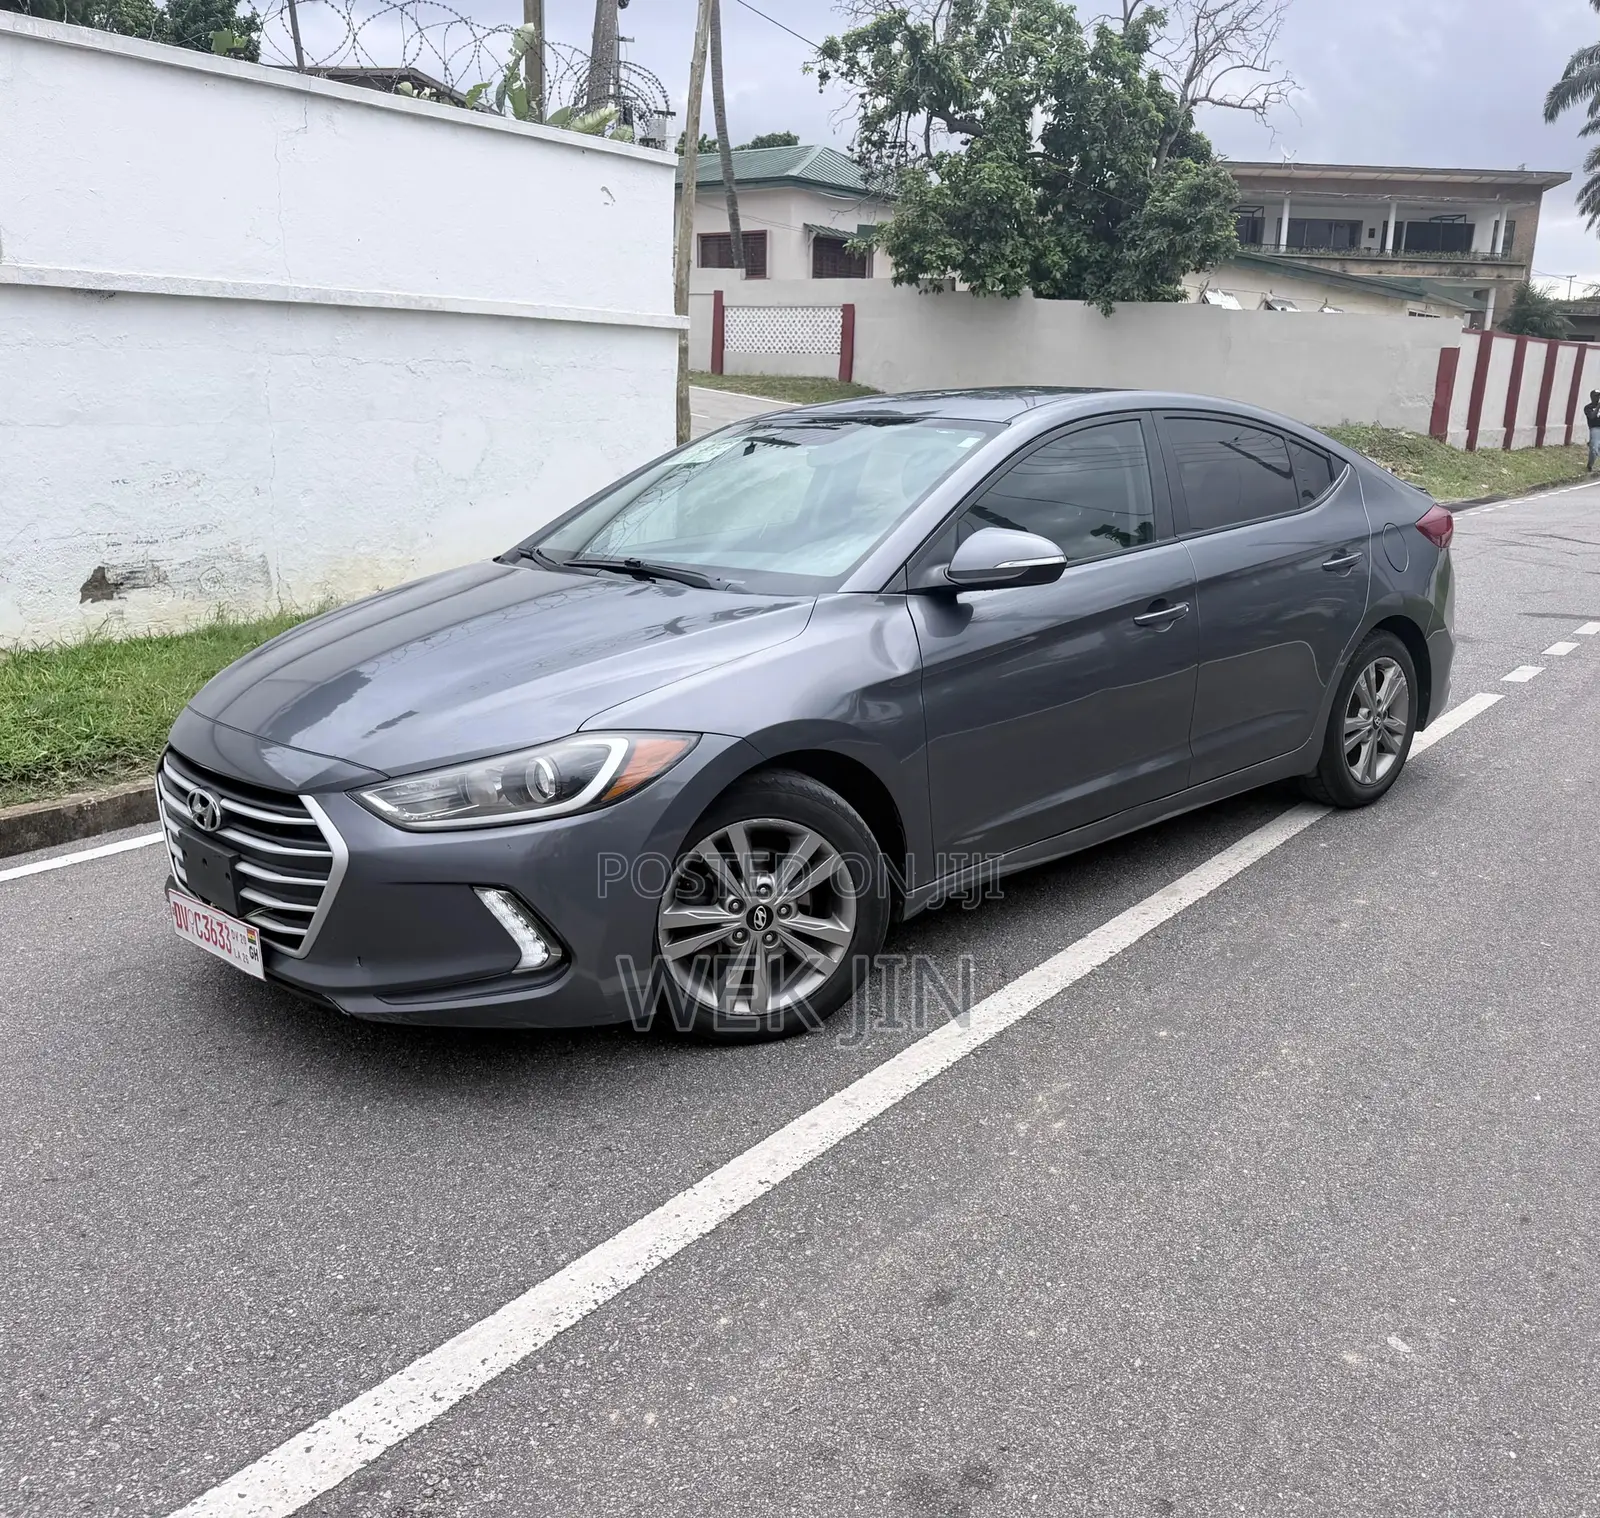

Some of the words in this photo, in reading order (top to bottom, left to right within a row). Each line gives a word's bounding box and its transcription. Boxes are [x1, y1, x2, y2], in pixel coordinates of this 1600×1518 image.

[173, 901, 189, 931] DV
[194, 912, 232, 954] C3633
[249, 945, 260, 962] GH
